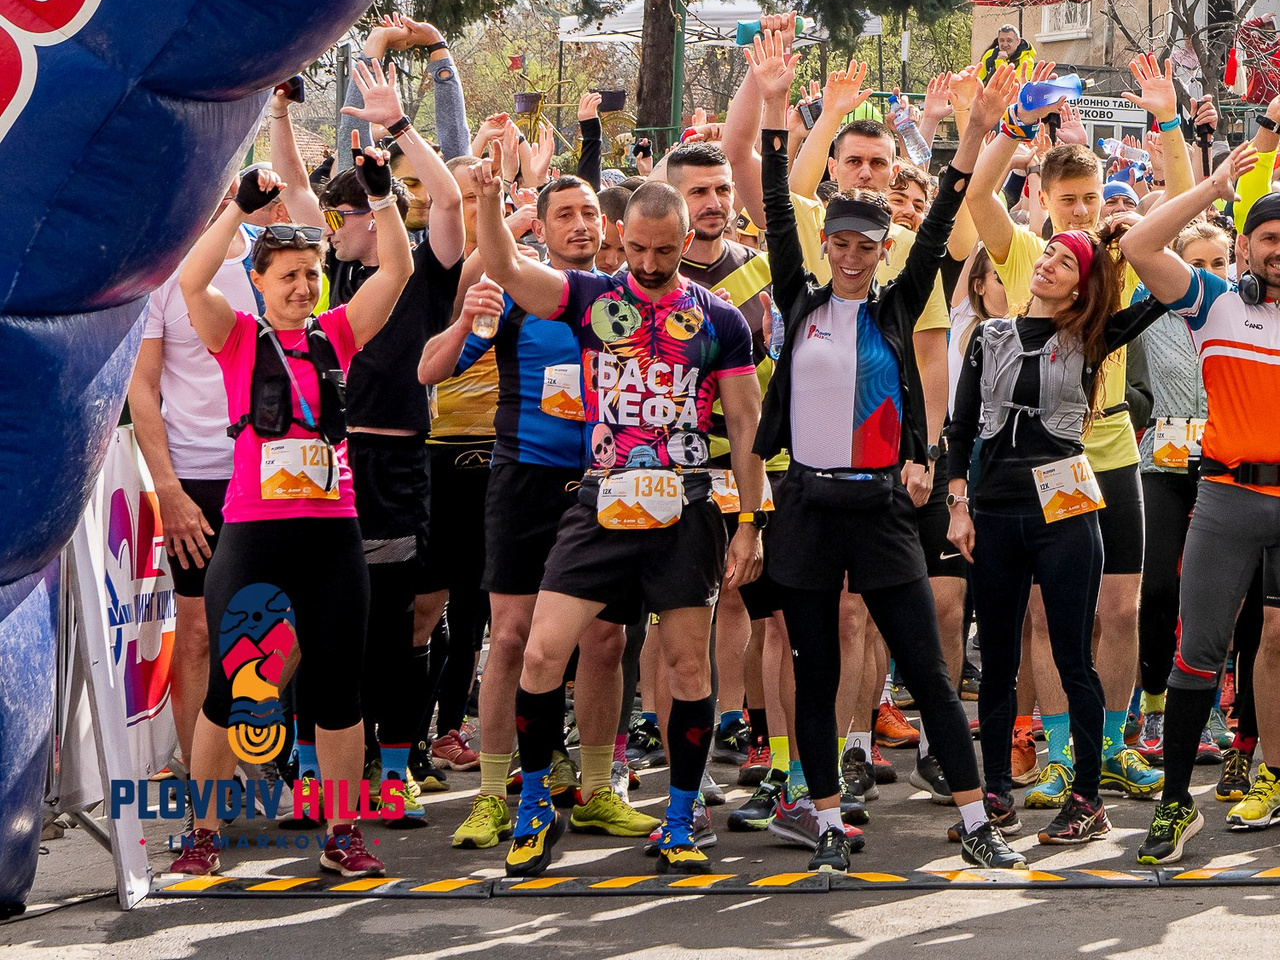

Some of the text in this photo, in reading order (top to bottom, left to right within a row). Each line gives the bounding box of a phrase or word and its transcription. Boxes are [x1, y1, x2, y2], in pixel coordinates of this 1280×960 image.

[1066, 97, 1109, 109] ЦИОННО
[598, 352, 699, 397] БАСИ
[598, 389, 698, 429] КЕФА
[634, 476, 678, 497] 1345
